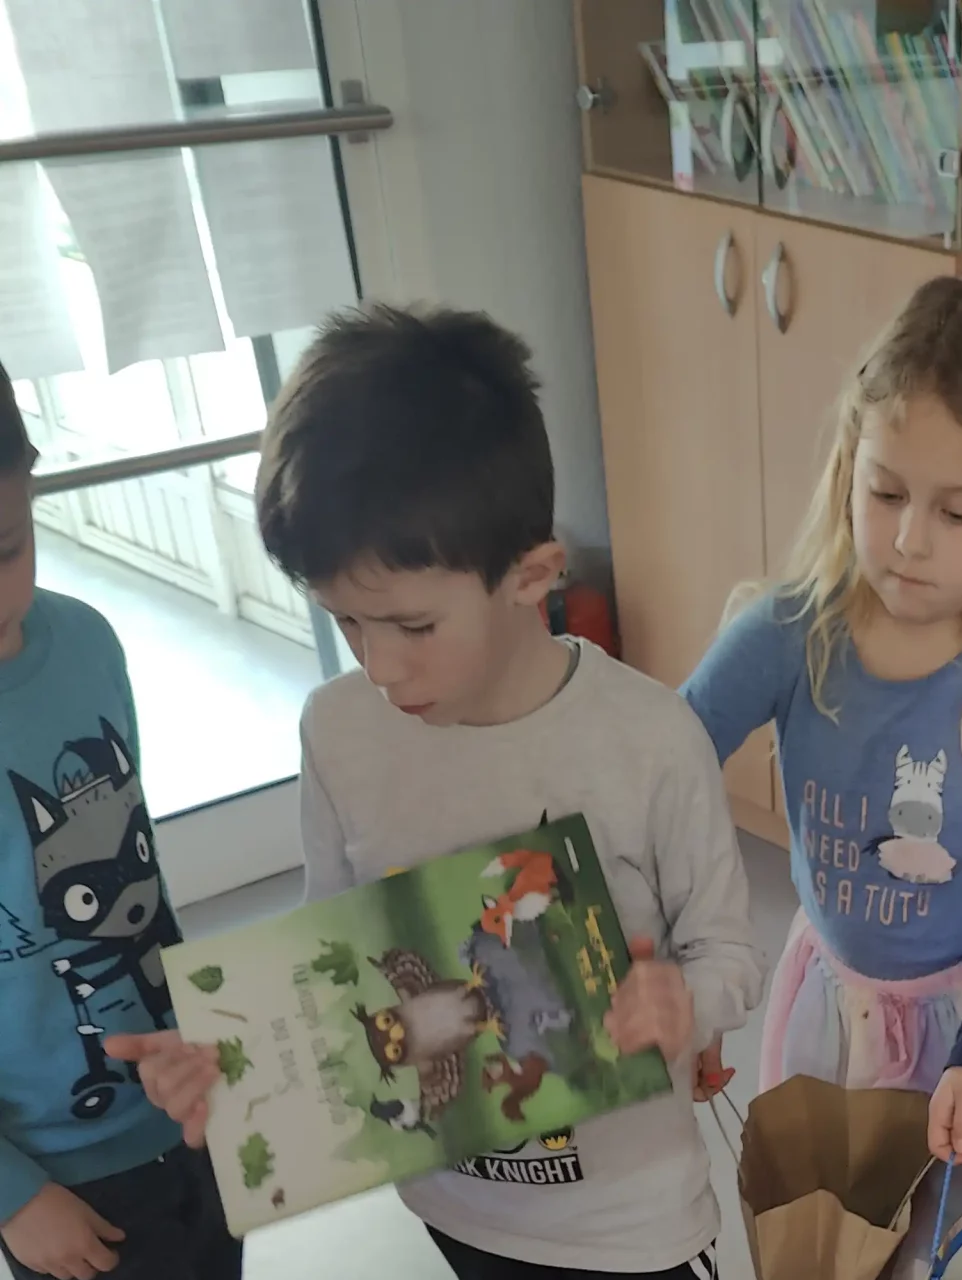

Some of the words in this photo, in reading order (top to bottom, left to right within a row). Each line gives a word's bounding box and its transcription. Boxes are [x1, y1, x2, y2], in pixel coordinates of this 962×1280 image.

[804, 779, 845, 829] ALL
[860, 795, 868, 832] I
[805, 829, 860, 872] NEED
[816, 870, 828, 906] S
[838, 879, 852, 915] A
[865, 884, 931, 925] TUTU
[485, 1156, 578, 1184] KNIGHT
